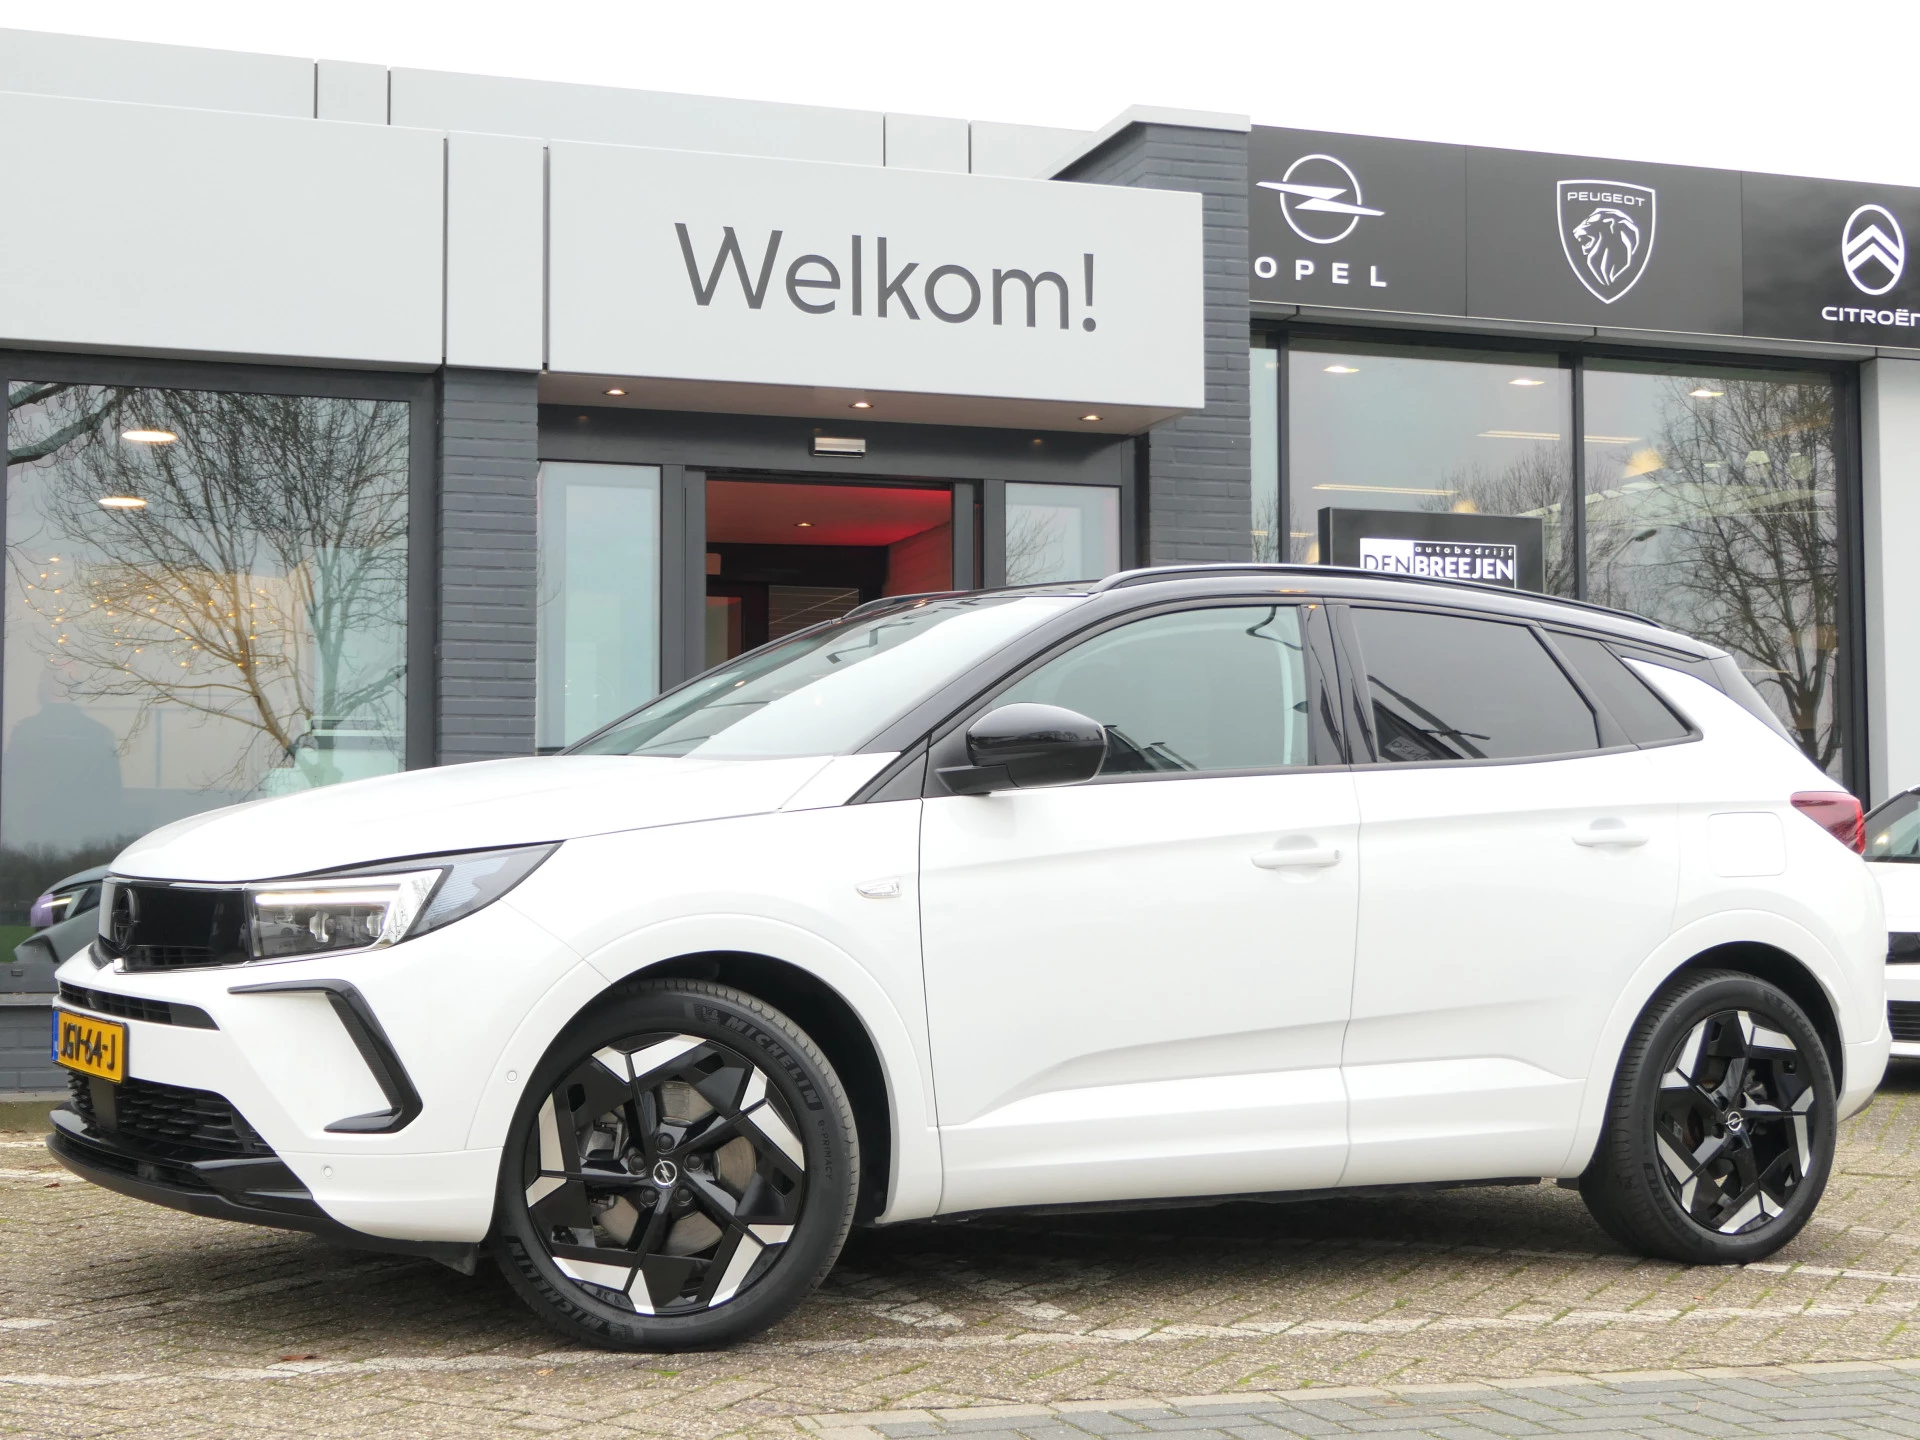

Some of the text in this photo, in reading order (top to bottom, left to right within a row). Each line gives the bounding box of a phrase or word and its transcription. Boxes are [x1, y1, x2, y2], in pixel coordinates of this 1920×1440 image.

[1567, 192, 1645, 207] PEUGEOT
[674, 222, 1097, 332] Welkom!
[1254, 256, 1387, 287] OPEL
[1415, 545, 1512, 557] autobedrijf
[726, 1016, 821, 1104] MICHELIN
[507, 1241, 604, 1331] MICHELIN
